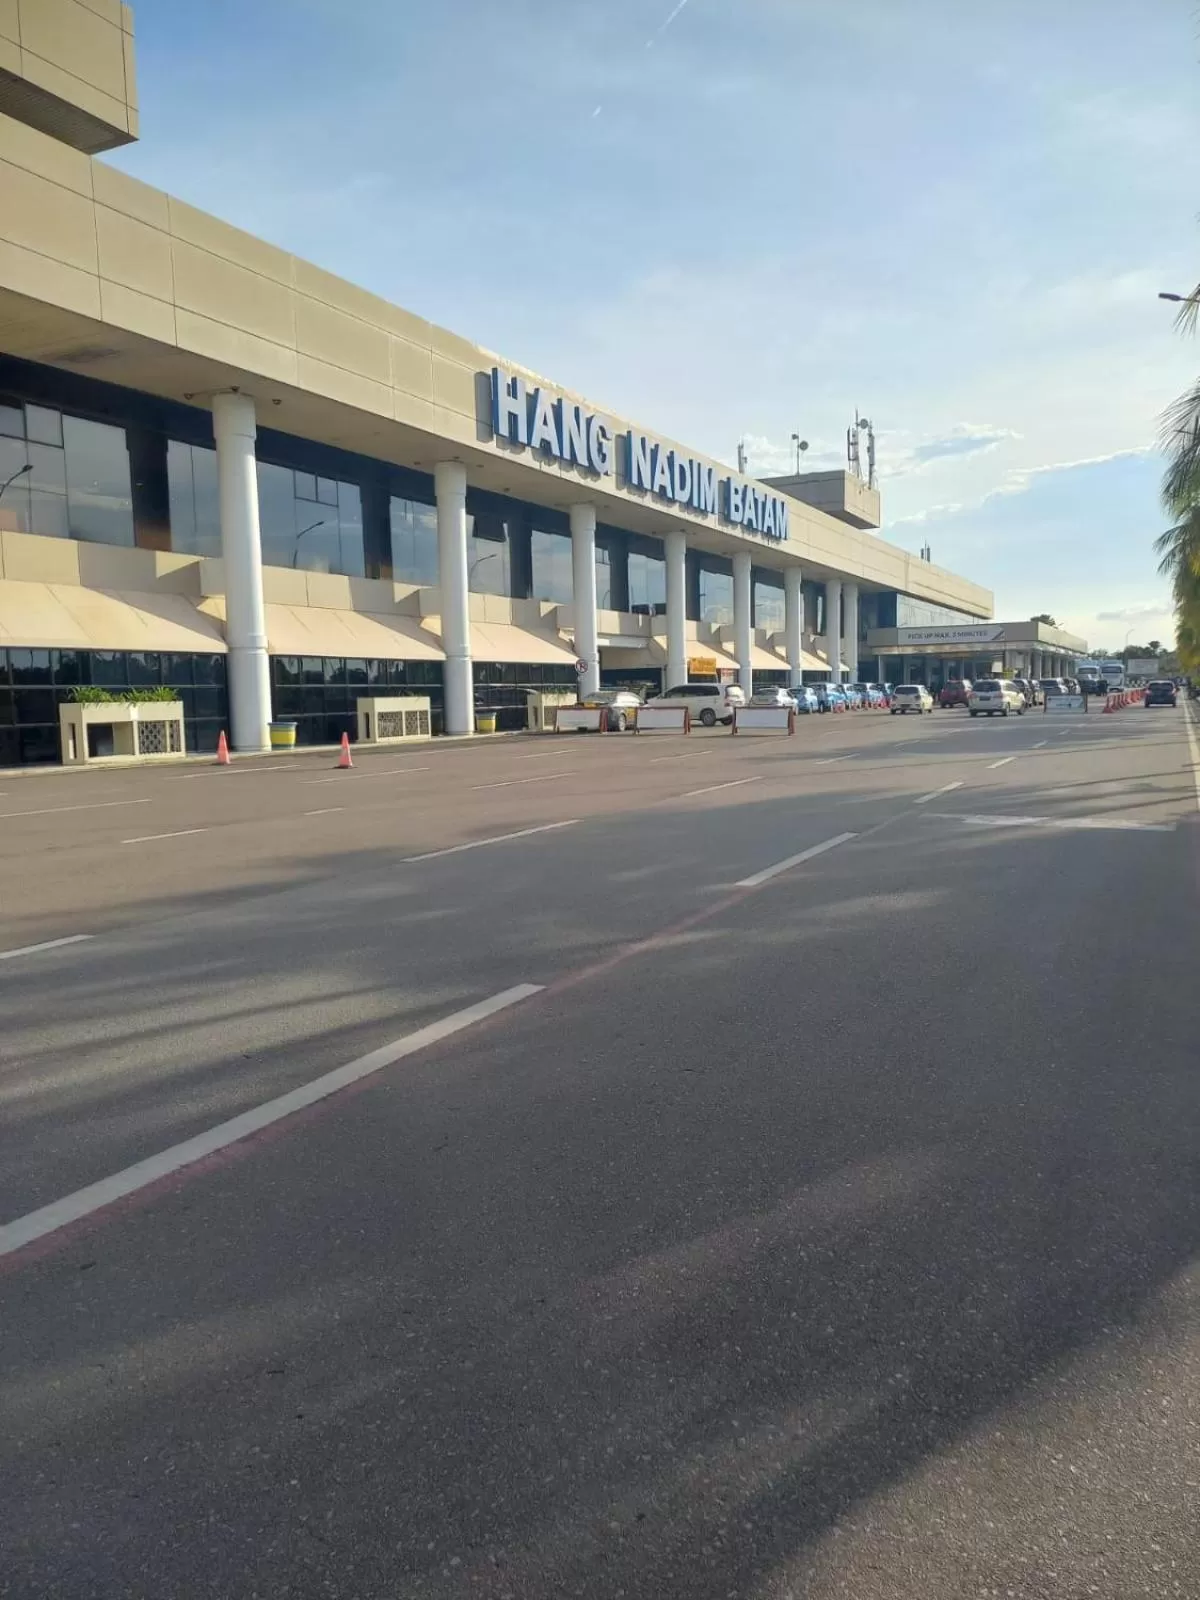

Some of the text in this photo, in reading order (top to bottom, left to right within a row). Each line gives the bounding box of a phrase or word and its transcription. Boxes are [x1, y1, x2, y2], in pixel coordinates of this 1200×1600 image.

[492, 367, 789, 540] HANG NADIM BATAM
